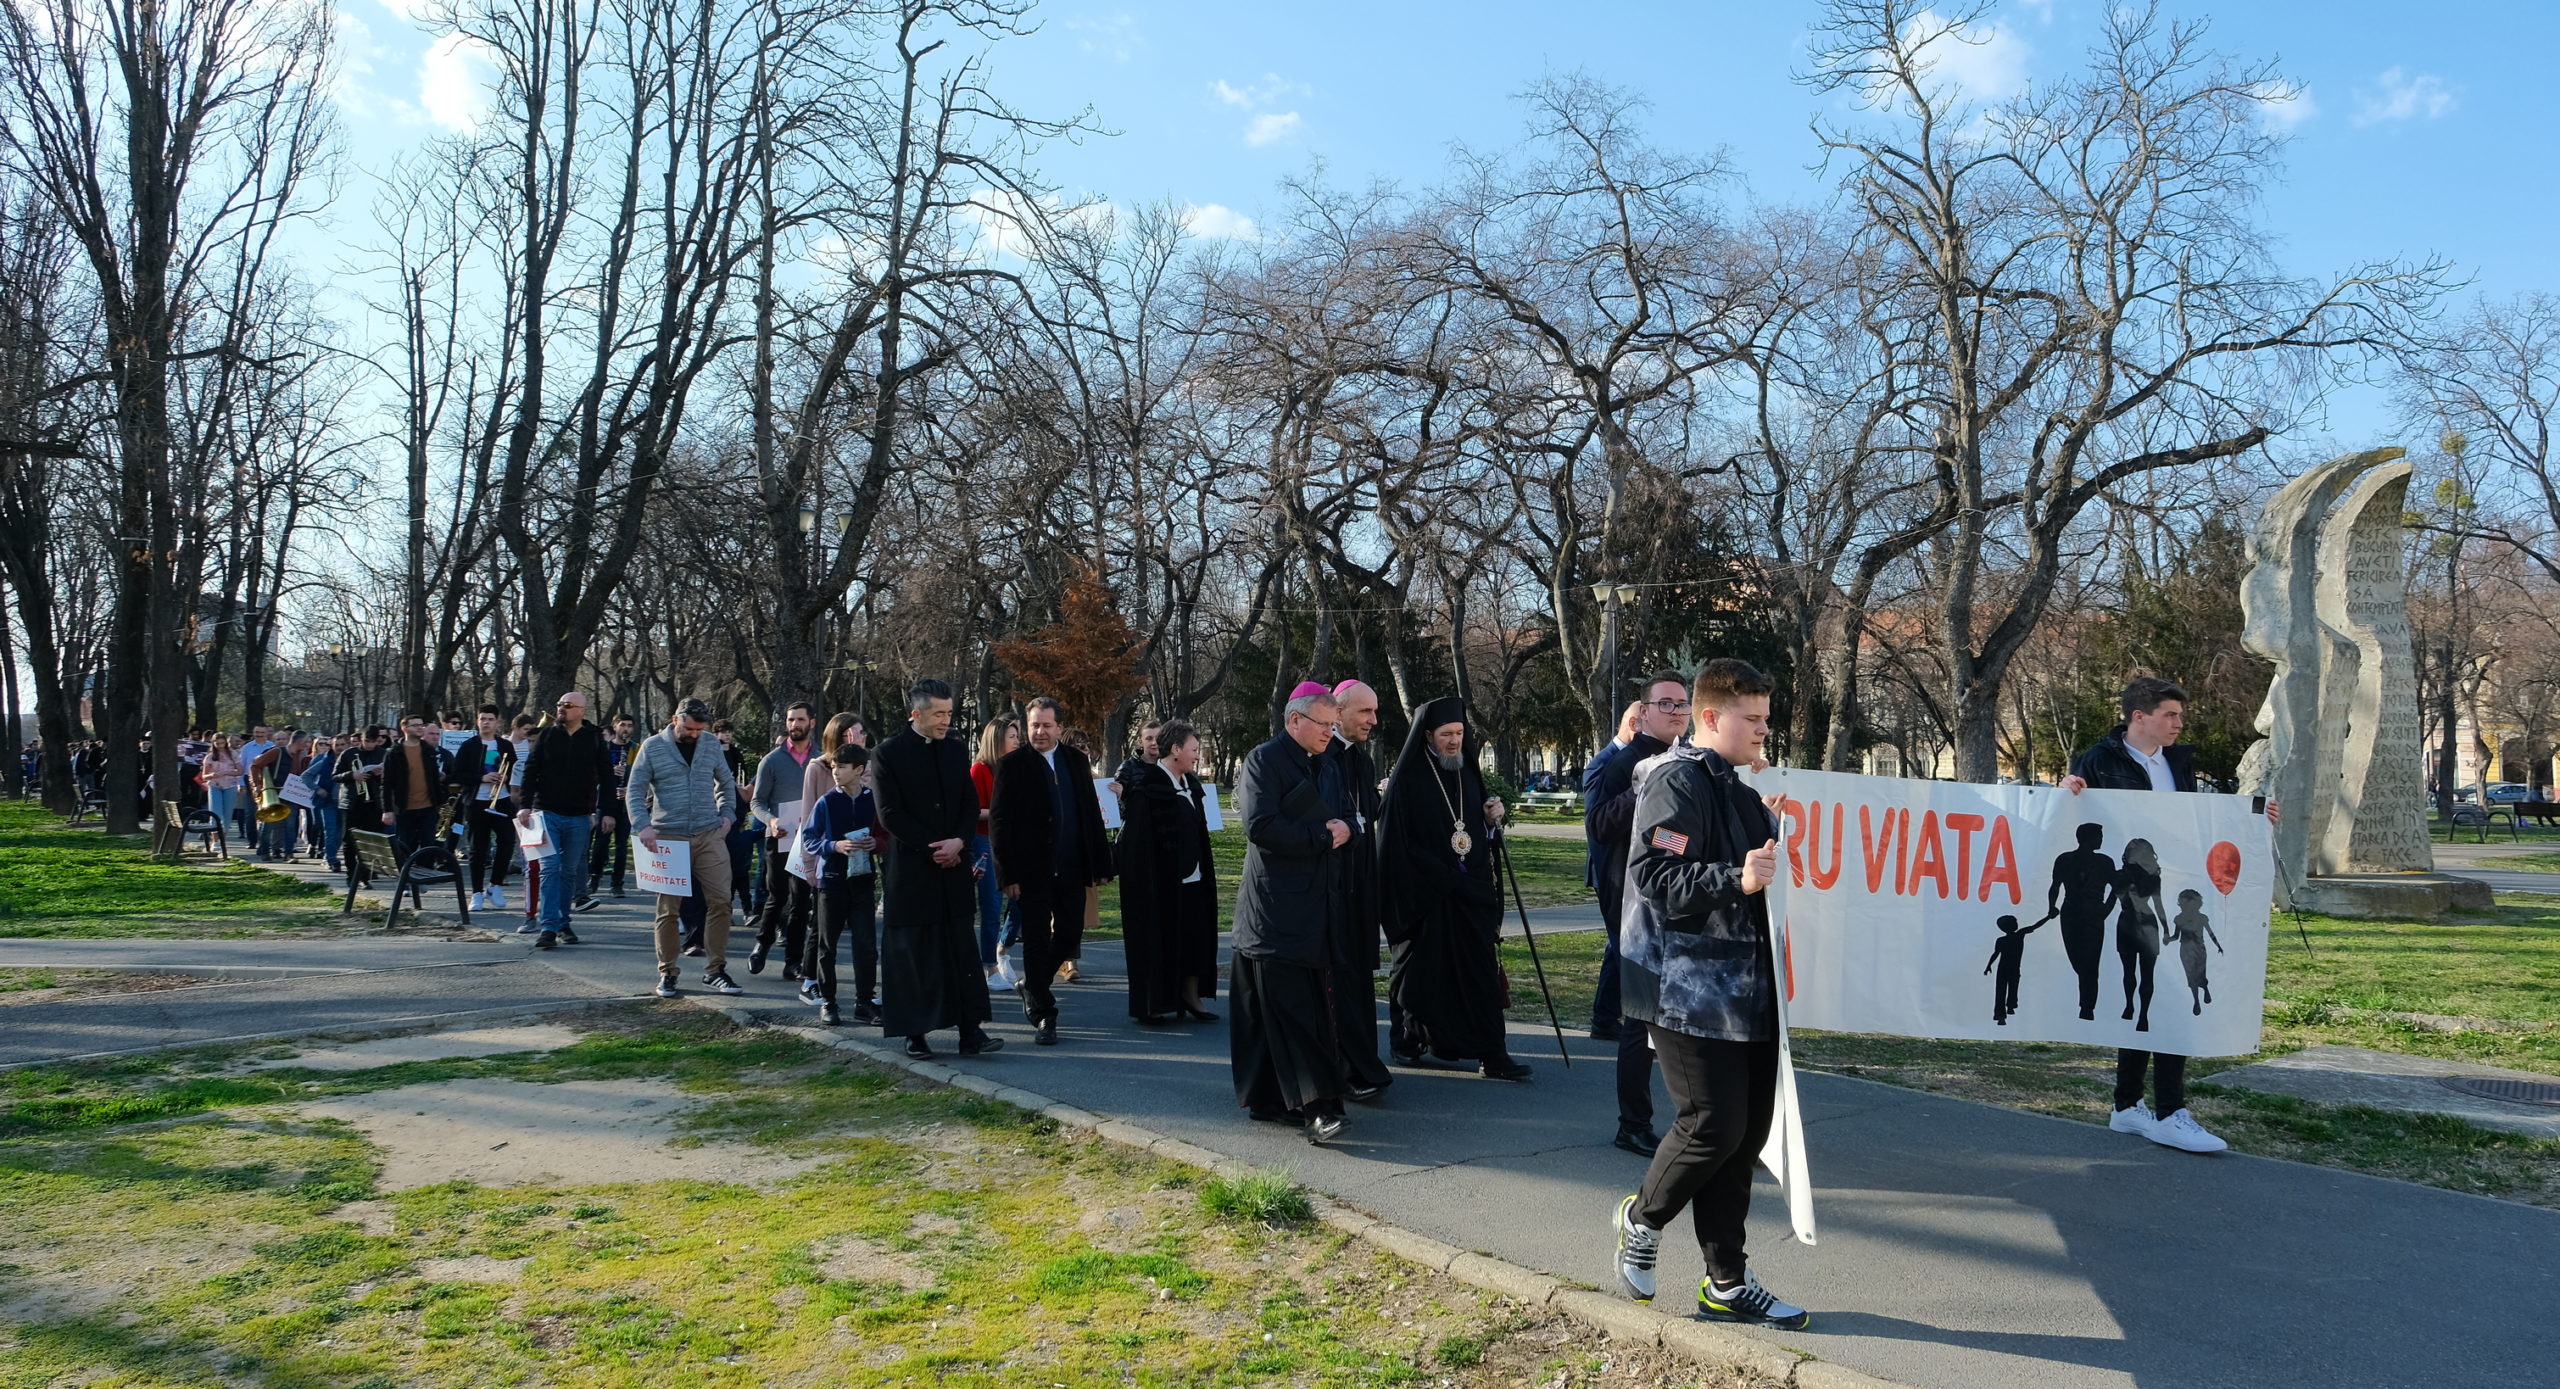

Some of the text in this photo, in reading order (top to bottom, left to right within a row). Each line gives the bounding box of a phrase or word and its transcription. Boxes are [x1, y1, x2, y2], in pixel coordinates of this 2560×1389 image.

[2355, 541, 2401, 553] BUCURIA
[2346, 570, 2402, 584] FERICIREA
[1858, 803, 2023, 906] VIATA
[651, 861, 668, 870] ARE
[639, 871, 688, 887] PRIORITATE
